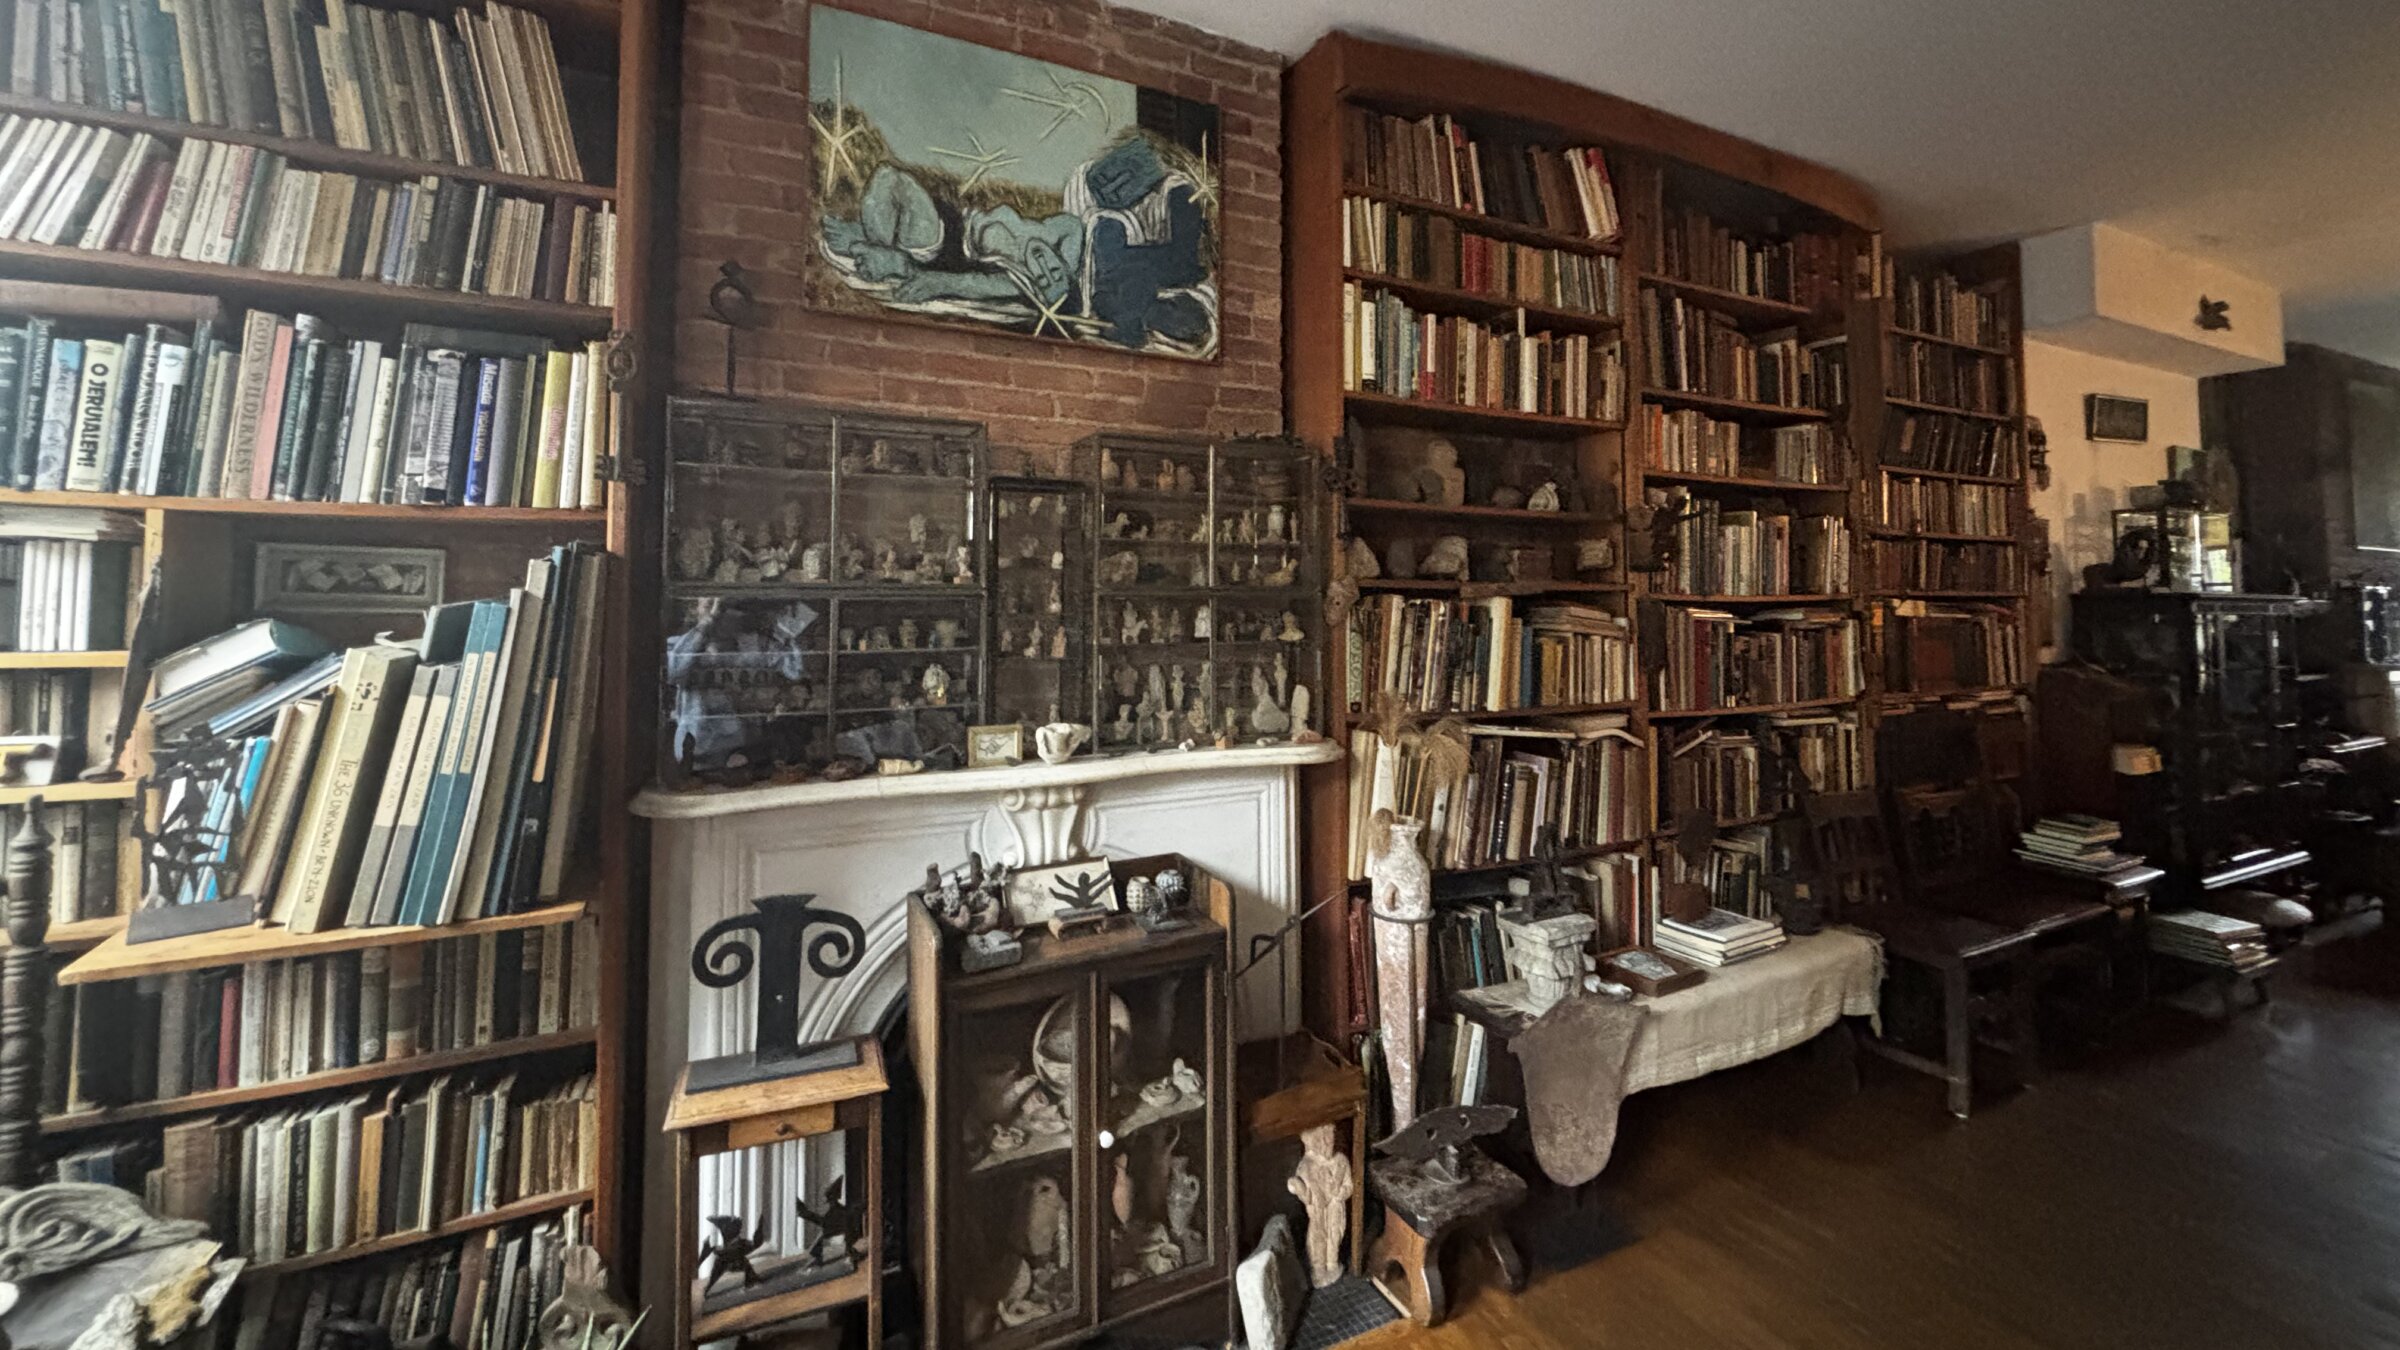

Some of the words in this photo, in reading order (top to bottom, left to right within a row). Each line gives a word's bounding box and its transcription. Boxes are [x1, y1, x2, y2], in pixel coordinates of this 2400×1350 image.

[91, 363, 109, 376] O
[480, 363, 498, 405] Masada
[235, 372, 264, 473] WILDERNESS
[332, 780, 352, 797] 36
[338, 759, 359, 776] THE
[319, 800, 343, 848] UNKNOWN
[304, 855, 327, 904] BEN-ZION
